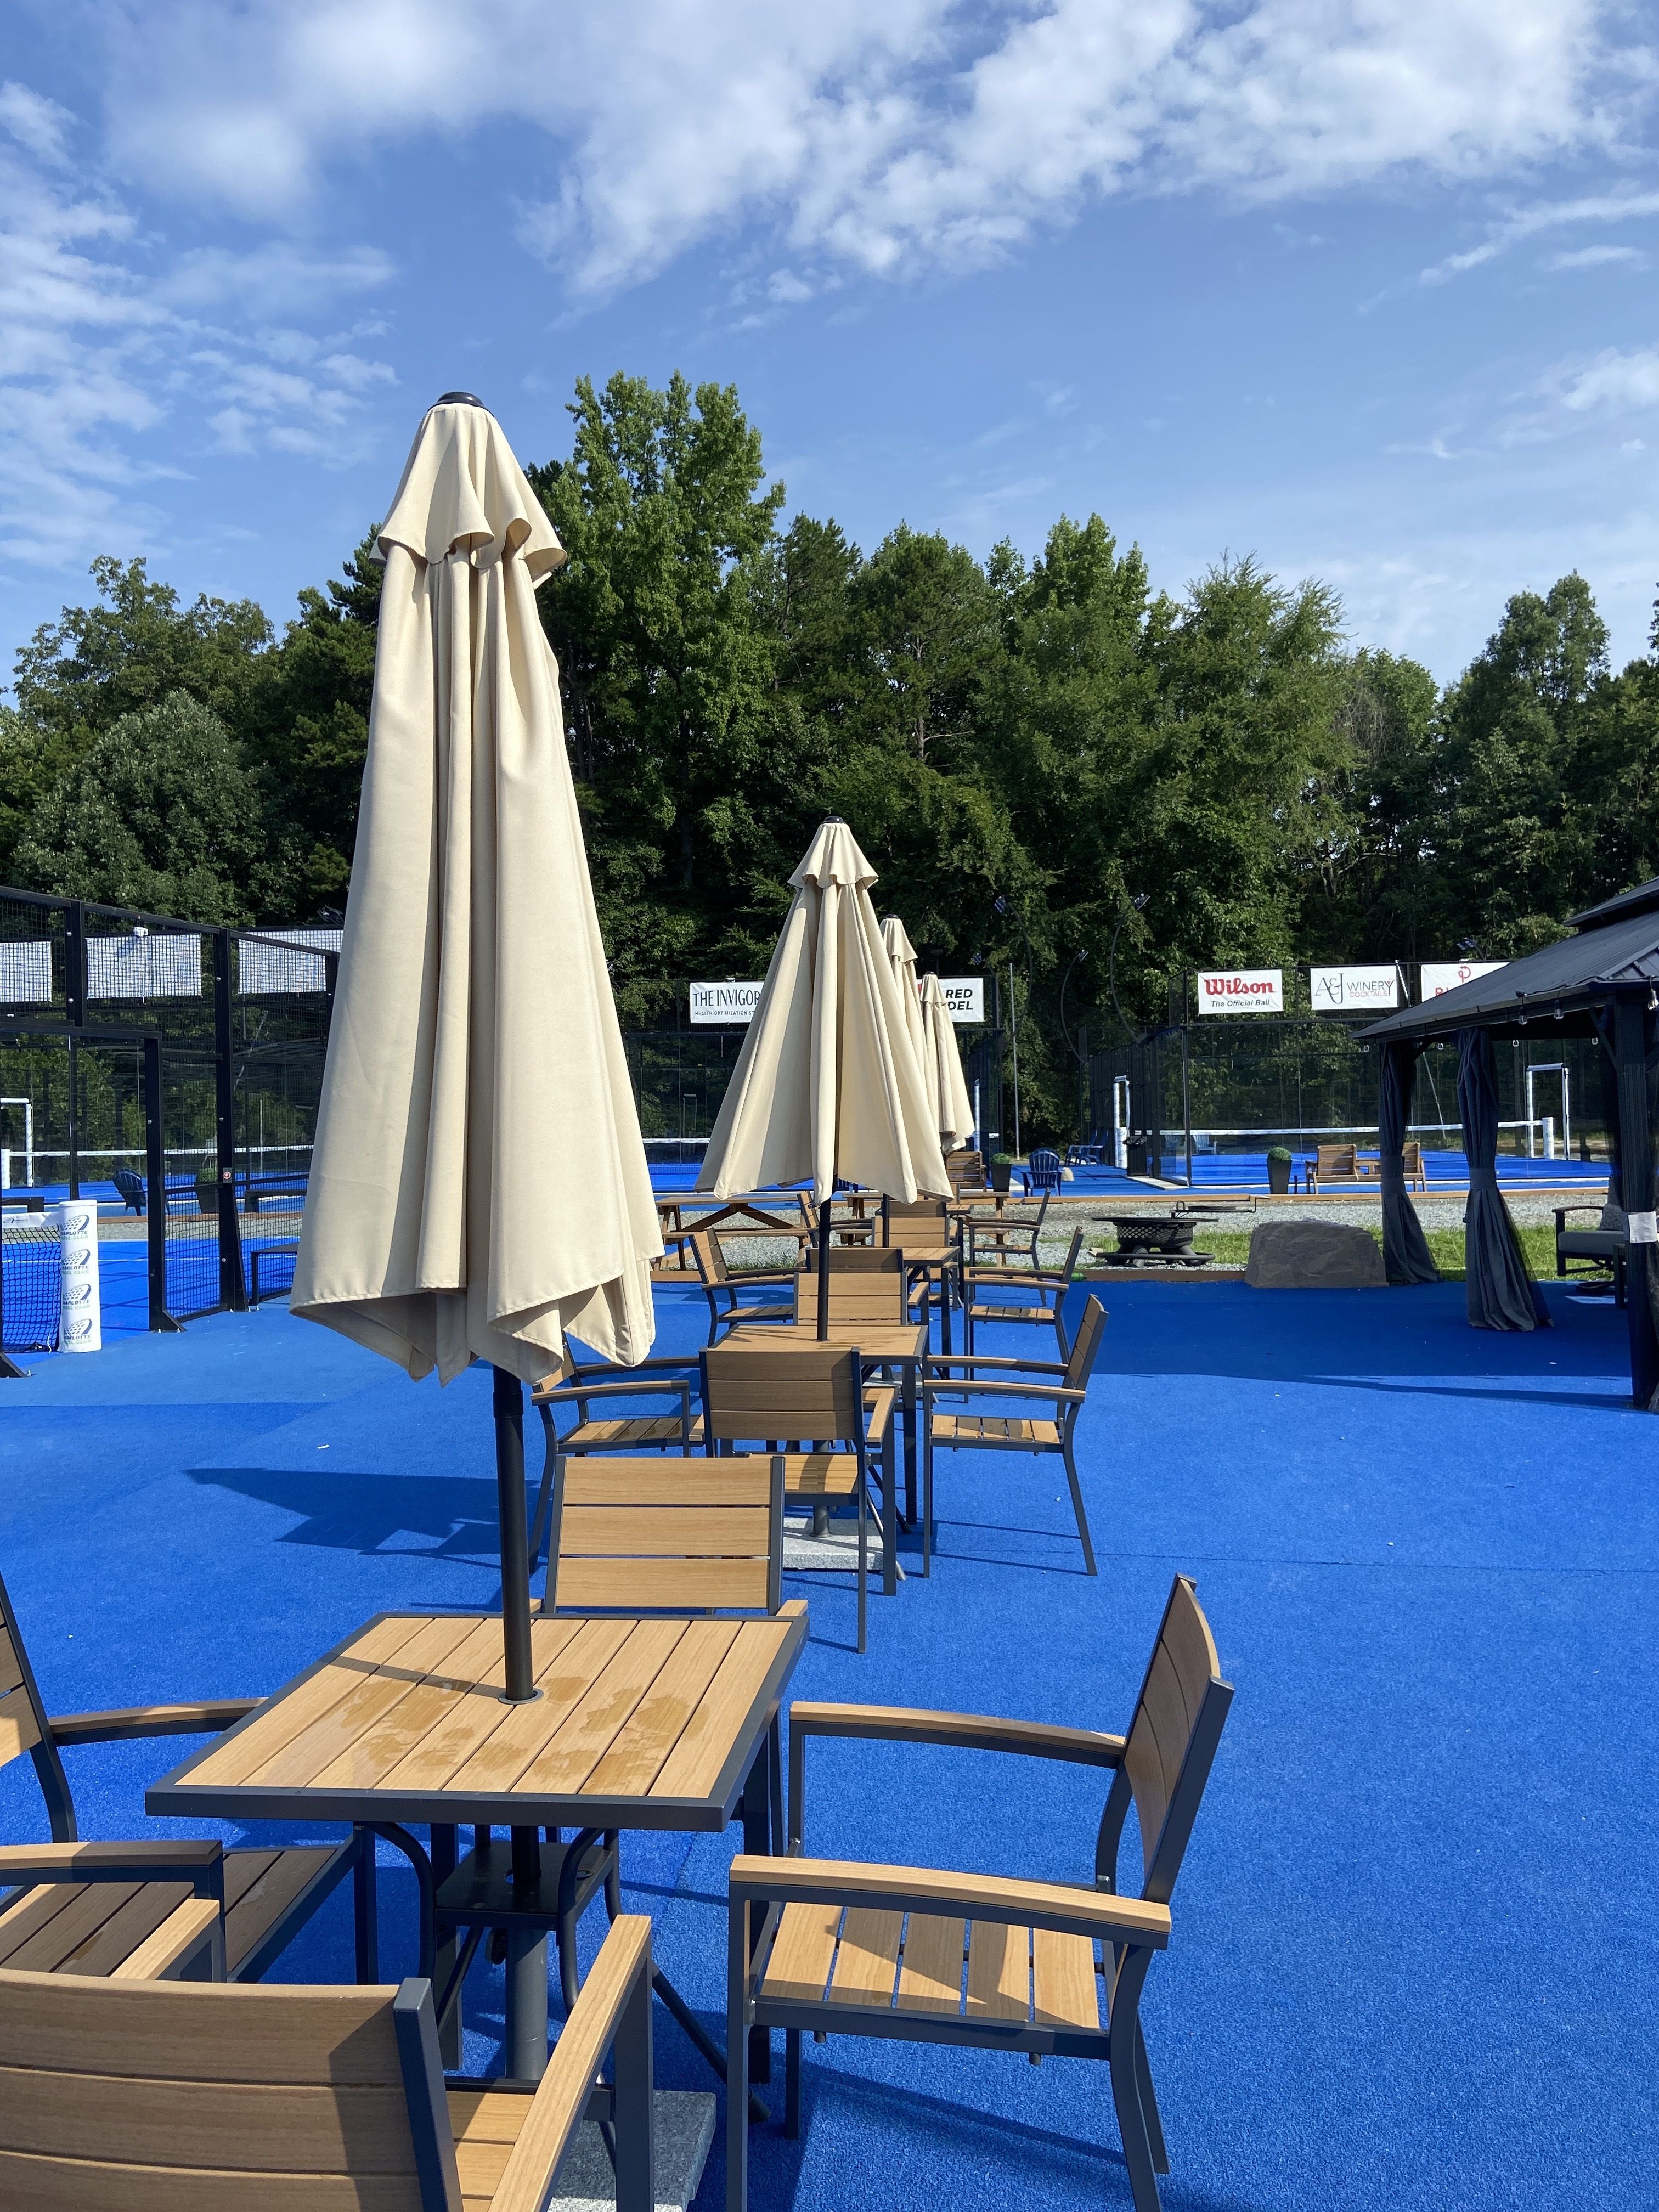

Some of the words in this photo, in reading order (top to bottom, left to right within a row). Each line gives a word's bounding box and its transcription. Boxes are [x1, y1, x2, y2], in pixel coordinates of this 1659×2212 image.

[1204, 978, 1274, 995] Wilson
[1346, 979, 1395, 996] WINERY
[693, 990, 714, 1006] THE
